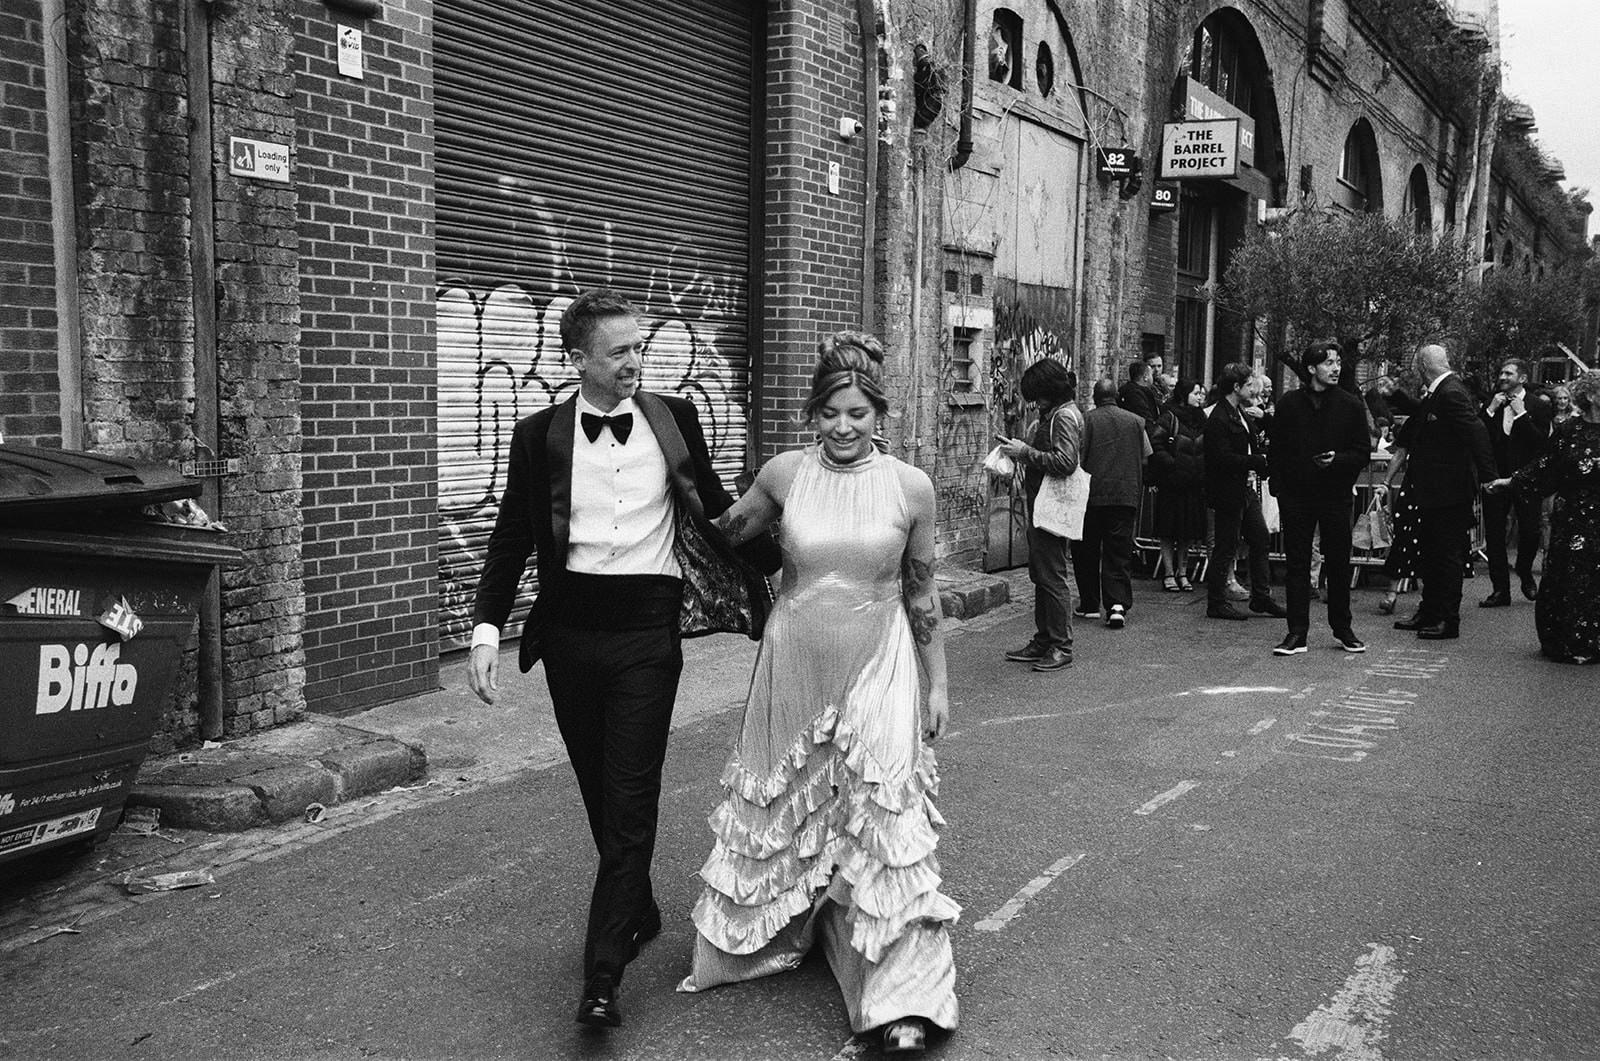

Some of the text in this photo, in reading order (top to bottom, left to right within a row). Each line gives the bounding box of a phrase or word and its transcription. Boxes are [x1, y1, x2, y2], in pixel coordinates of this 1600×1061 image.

[1187, 130, 1213, 141] THE
[1174, 143, 1225, 155] BARREL
[257, 149, 287, 163] Loading
[1108, 153, 1125, 166] 82
[264, 163, 281, 174] only
[1170, 157, 1227, 170] PROJECT
[1155, 189, 1171, 201] 80
[36, 642, 138, 715] Biffa
